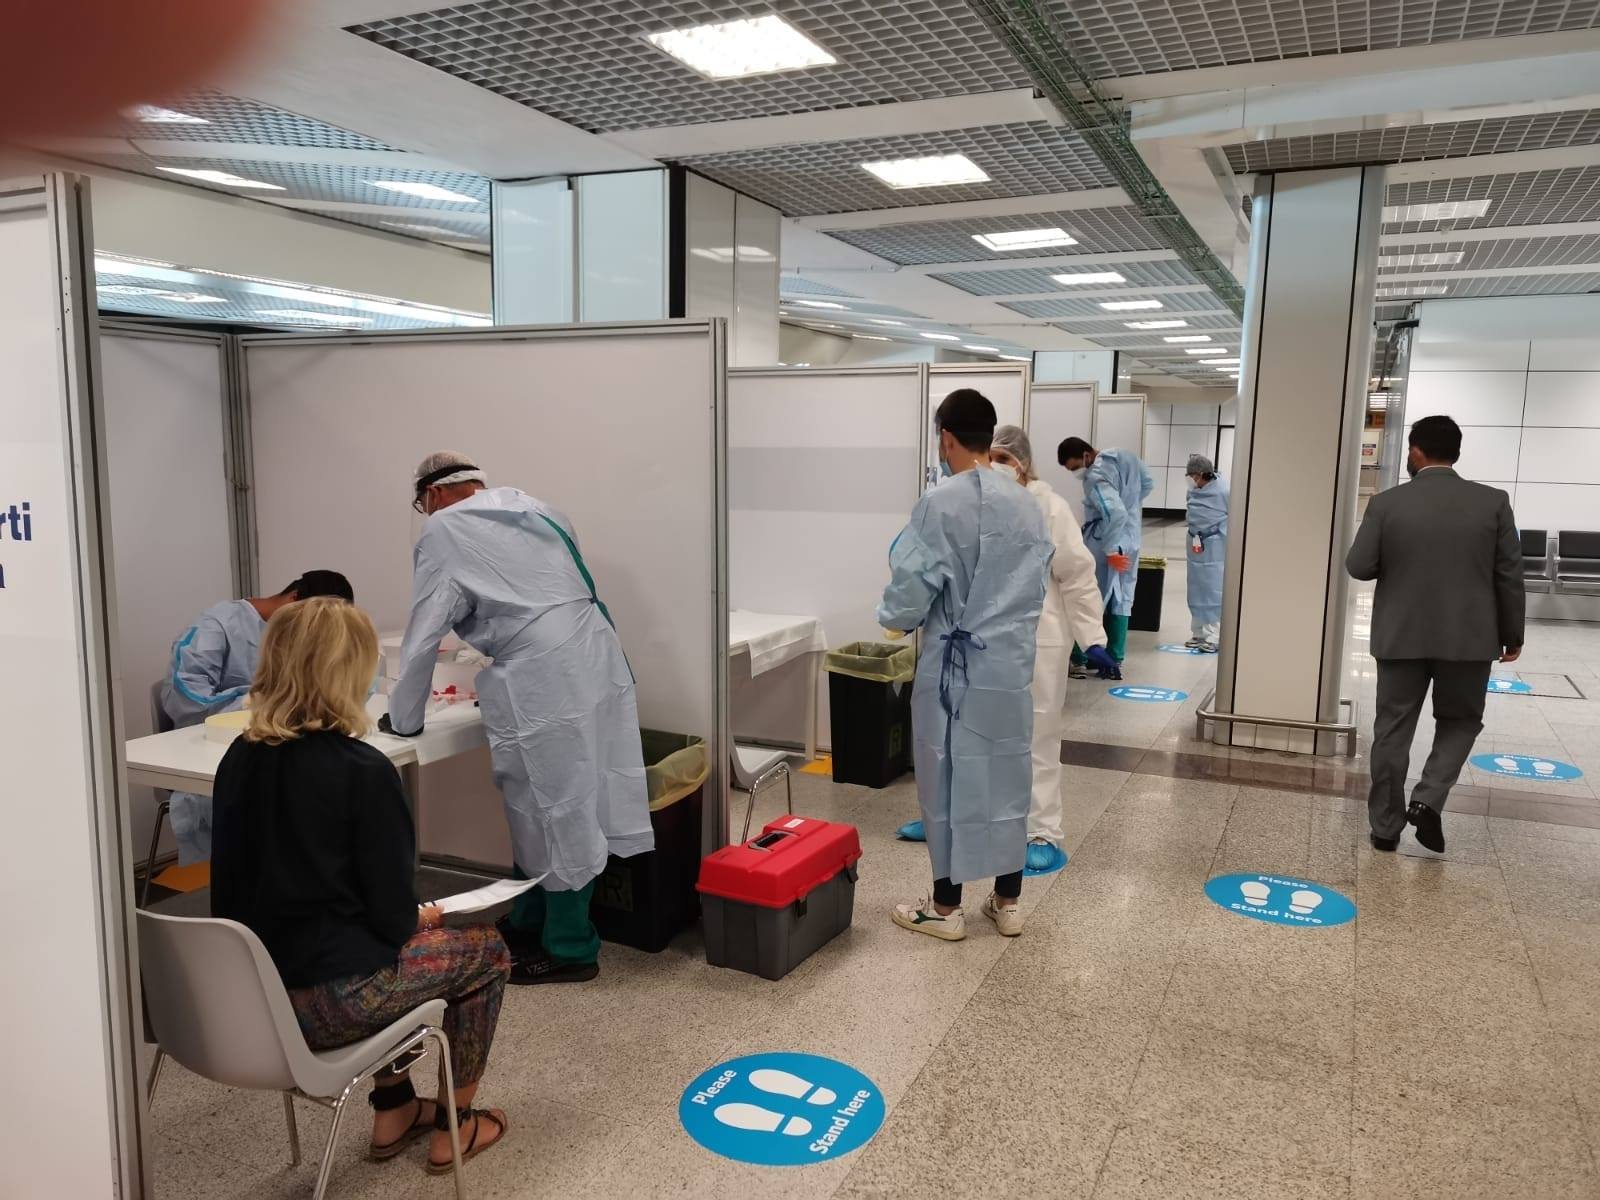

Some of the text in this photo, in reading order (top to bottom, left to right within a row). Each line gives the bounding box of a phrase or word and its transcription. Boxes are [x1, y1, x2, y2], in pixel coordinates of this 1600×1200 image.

[1258, 876, 1309, 889] Please
[1231, 903, 1323, 924] Stand here
[691, 1069, 737, 1105] Please
[809, 1089, 871, 1155] Stand here
